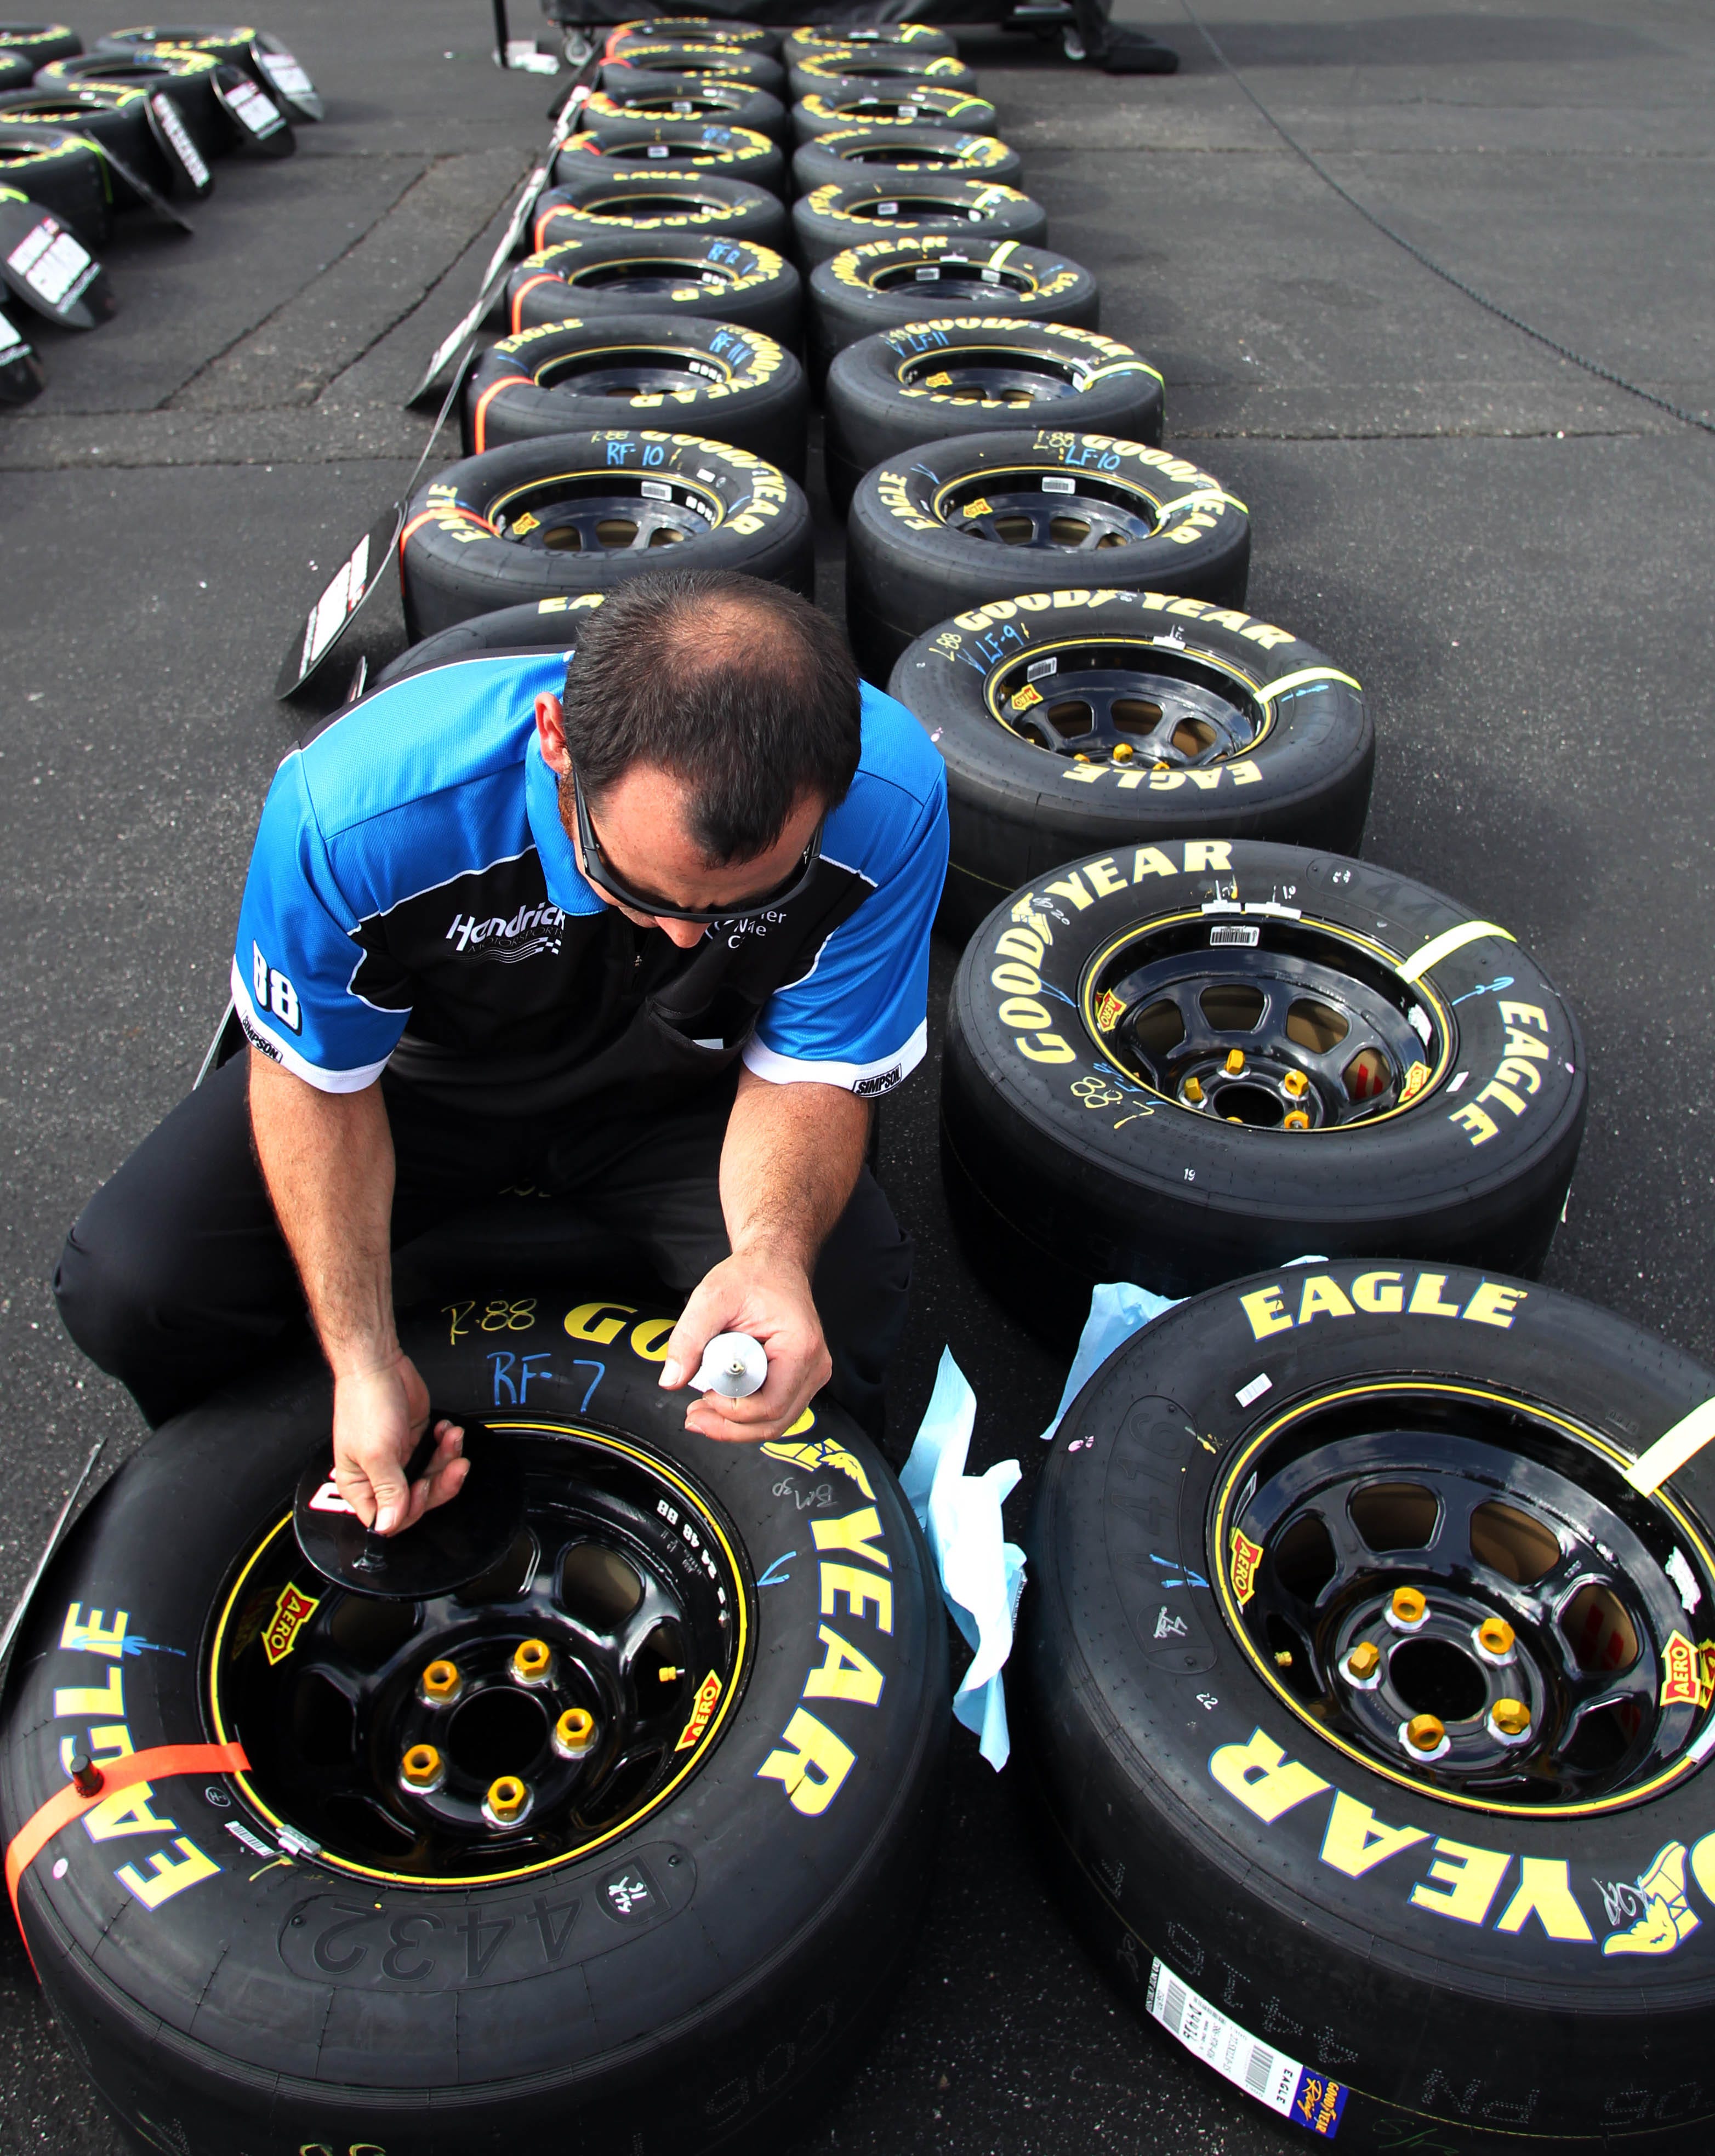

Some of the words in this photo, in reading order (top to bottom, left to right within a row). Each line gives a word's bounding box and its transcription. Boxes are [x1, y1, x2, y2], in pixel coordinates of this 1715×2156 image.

[1062, 760, 1263, 791] EAGLE
[445, 902, 566, 952] Hendrick
[252, 939, 302, 1036] 88
[857, 1066, 901, 1096] SIMPSON
[1448, 1000, 1551, 1147] EAGLE
[1238, 1271, 1528, 1342] EAGLE
[1232, 1539, 1252, 1592] AERO
[270, 1594, 303, 1650] AERO
[1671, 1635, 1691, 1696] AERO
[691, 1684, 717, 1740] AERO
[1276, 2068, 1294, 2105] EAGLE
